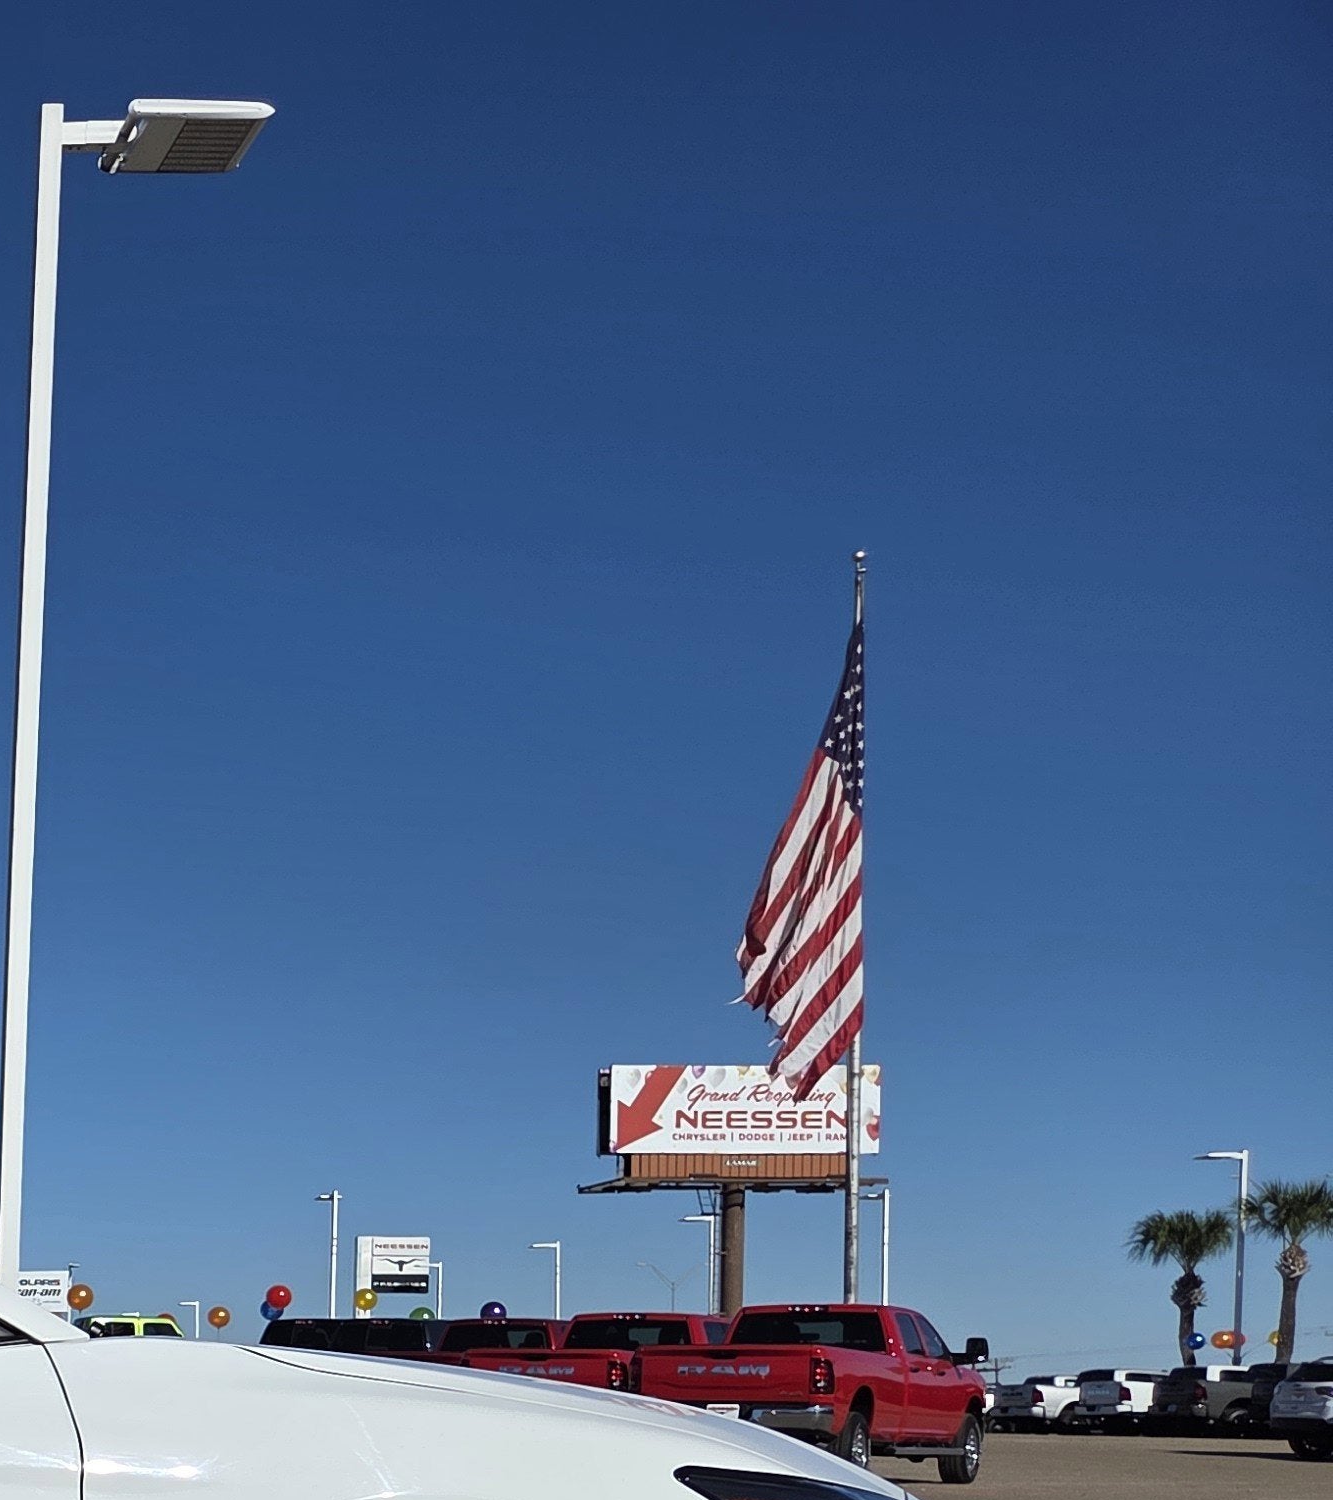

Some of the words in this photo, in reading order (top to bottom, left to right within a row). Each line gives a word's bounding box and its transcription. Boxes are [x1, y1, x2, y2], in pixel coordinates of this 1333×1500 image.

[687, 1083, 746, 1110] Grand
[747, 1083, 837, 1109] Reoping
[675, 1110, 847, 1129] NEESSEN
[672, 1133, 726, 1141] CHRYSLER
[738, 1133, 775, 1141] DODGE
[787, 1133, 813, 1141] JEEP
[825, 1133, 847, 1141] RAM
[18, 1288, 61, 1296] an-am
